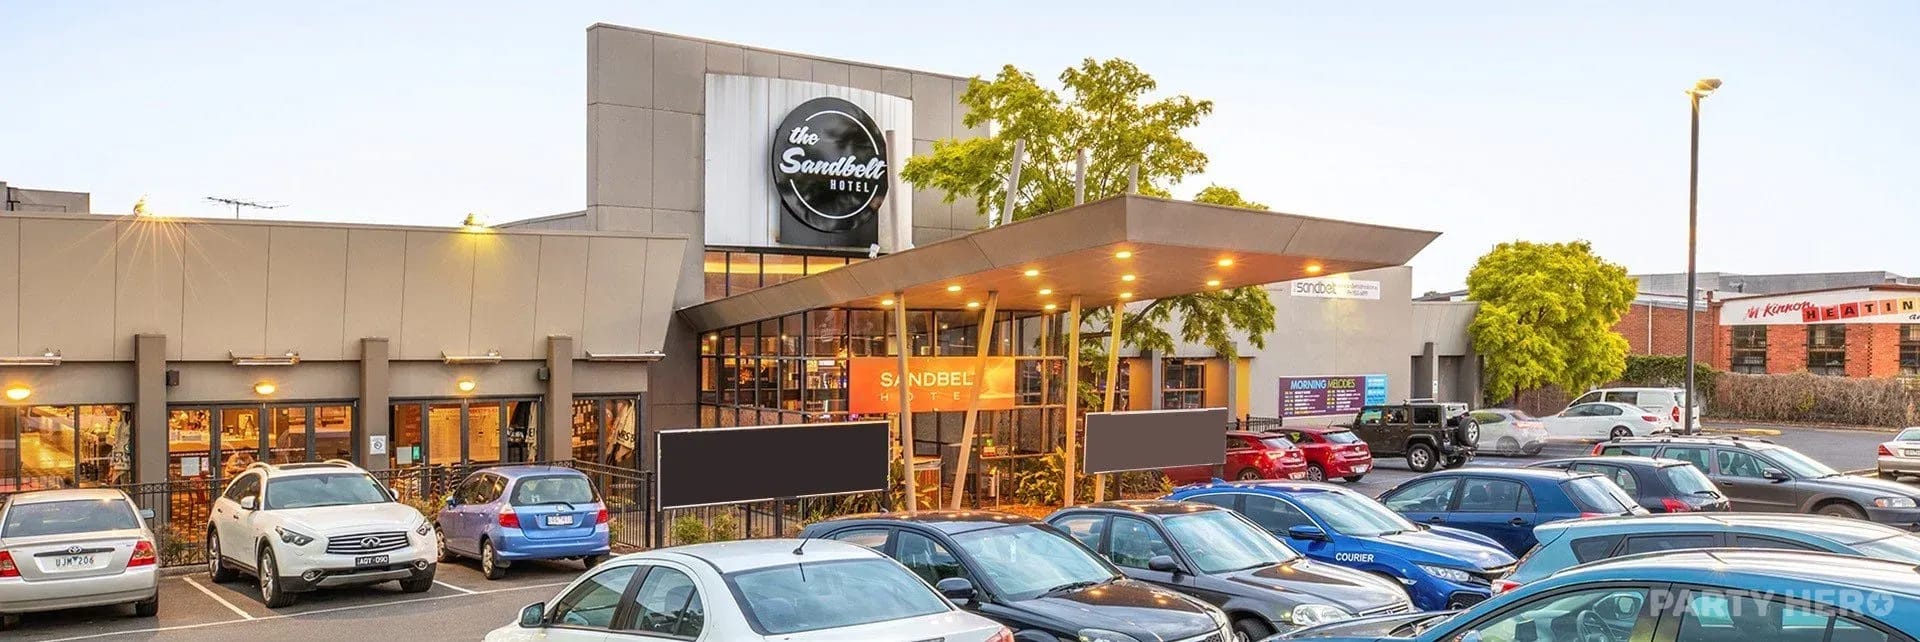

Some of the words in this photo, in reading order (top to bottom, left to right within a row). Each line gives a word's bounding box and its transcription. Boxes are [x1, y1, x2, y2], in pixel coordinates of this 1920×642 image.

[789, 126, 820, 145] the
[780, 147, 887, 180] Sandbelt
[830, 179, 869, 193] HOTEL
[1806, 301, 1914, 319] HEATIN
[880, 371, 976, 388] SNDBEL
[1290, 379, 1327, 390] MORNING
[880, 391, 961, 402] HTE
[1335, 552, 1375, 563] COURIER
